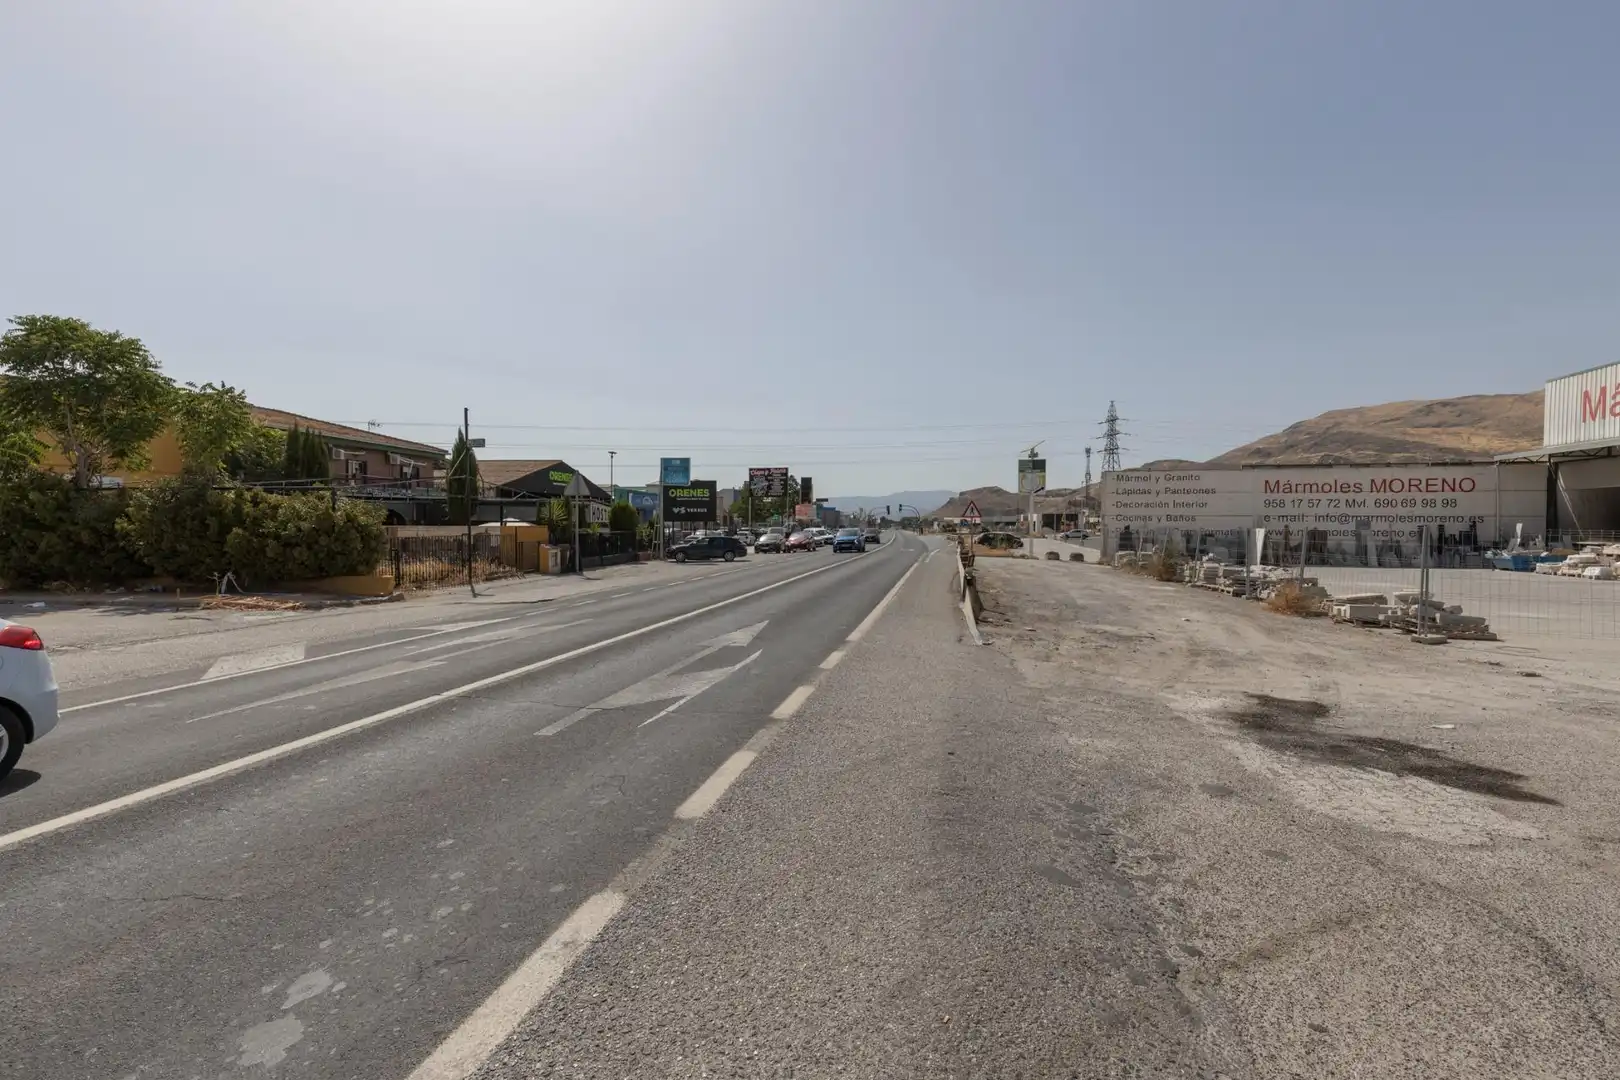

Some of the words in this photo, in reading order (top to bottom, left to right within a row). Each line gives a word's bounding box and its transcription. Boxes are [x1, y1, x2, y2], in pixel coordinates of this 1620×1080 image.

[1155, 476, 1161, 484] y
[1164, 473, 1201, 481] Granito
[1264, 479, 1363, 494] Mármoles
[1370, 478, 1476, 493] MORENO
[668, 488, 711, 498] ORENES
[1155, 489, 1161, 498] y
[1164, 487, 1217, 495] Panteones
[1173, 500, 1209, 509] Interior
[1263, 498, 1286, 508] 958
[1291, 499, 1303, 508] 17
[1307, 499, 1321, 508] 57
[1327, 499, 1341, 508] 72
[1374, 498, 1398, 508] 690
[1400, 498, 1417, 508] 69
[1420, 498, 1437, 508] 98
[1441, 498, 1458, 508] 98
[1165, 514, 1197, 522] Baños
